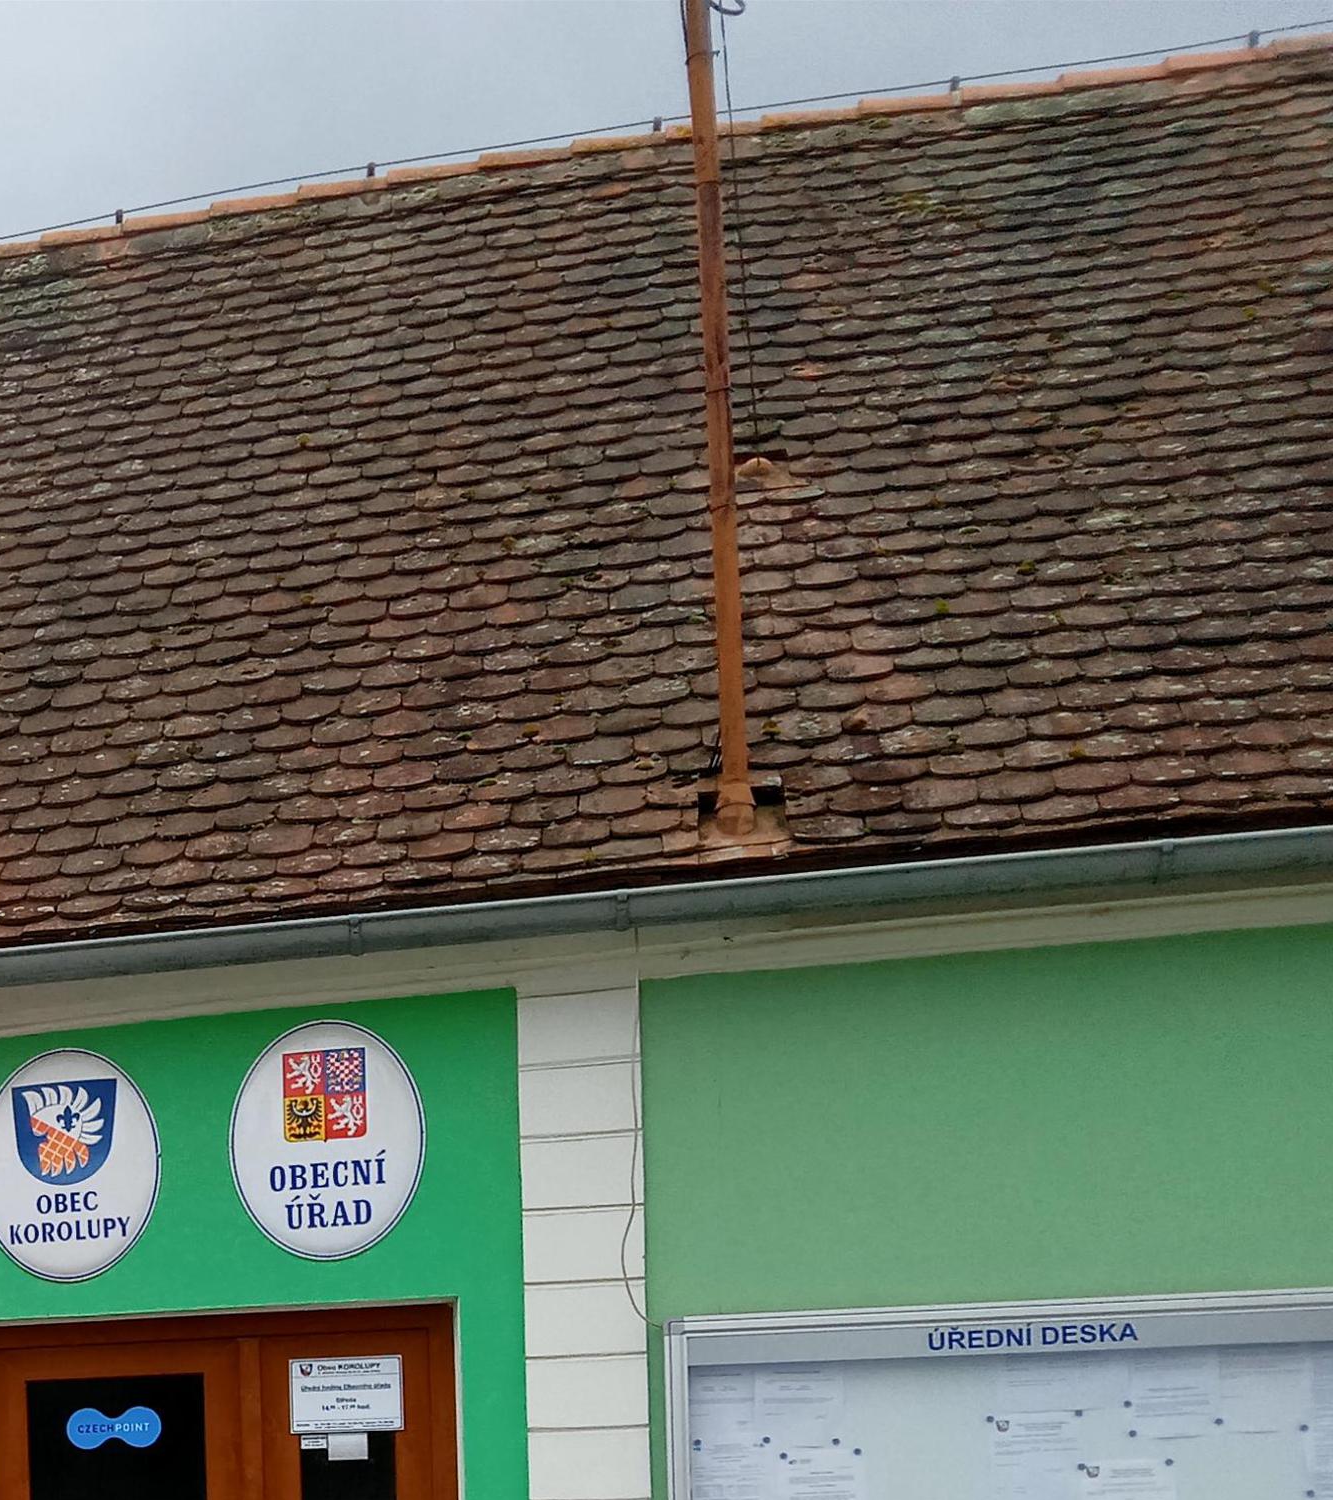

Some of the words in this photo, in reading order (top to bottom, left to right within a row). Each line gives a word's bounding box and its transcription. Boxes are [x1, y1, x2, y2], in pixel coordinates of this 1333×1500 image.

[269, 1149, 386, 1192] OBECNÍ
[36, 1191, 98, 1214] OBEC
[285, 1193, 372, 1230] ÚŘAD
[9, 1216, 131, 1245] KOROLUPY
[928, 1323, 1032, 1351] ÚŘEDNÍ
[1041, 1323, 1138, 1345] DESKA
